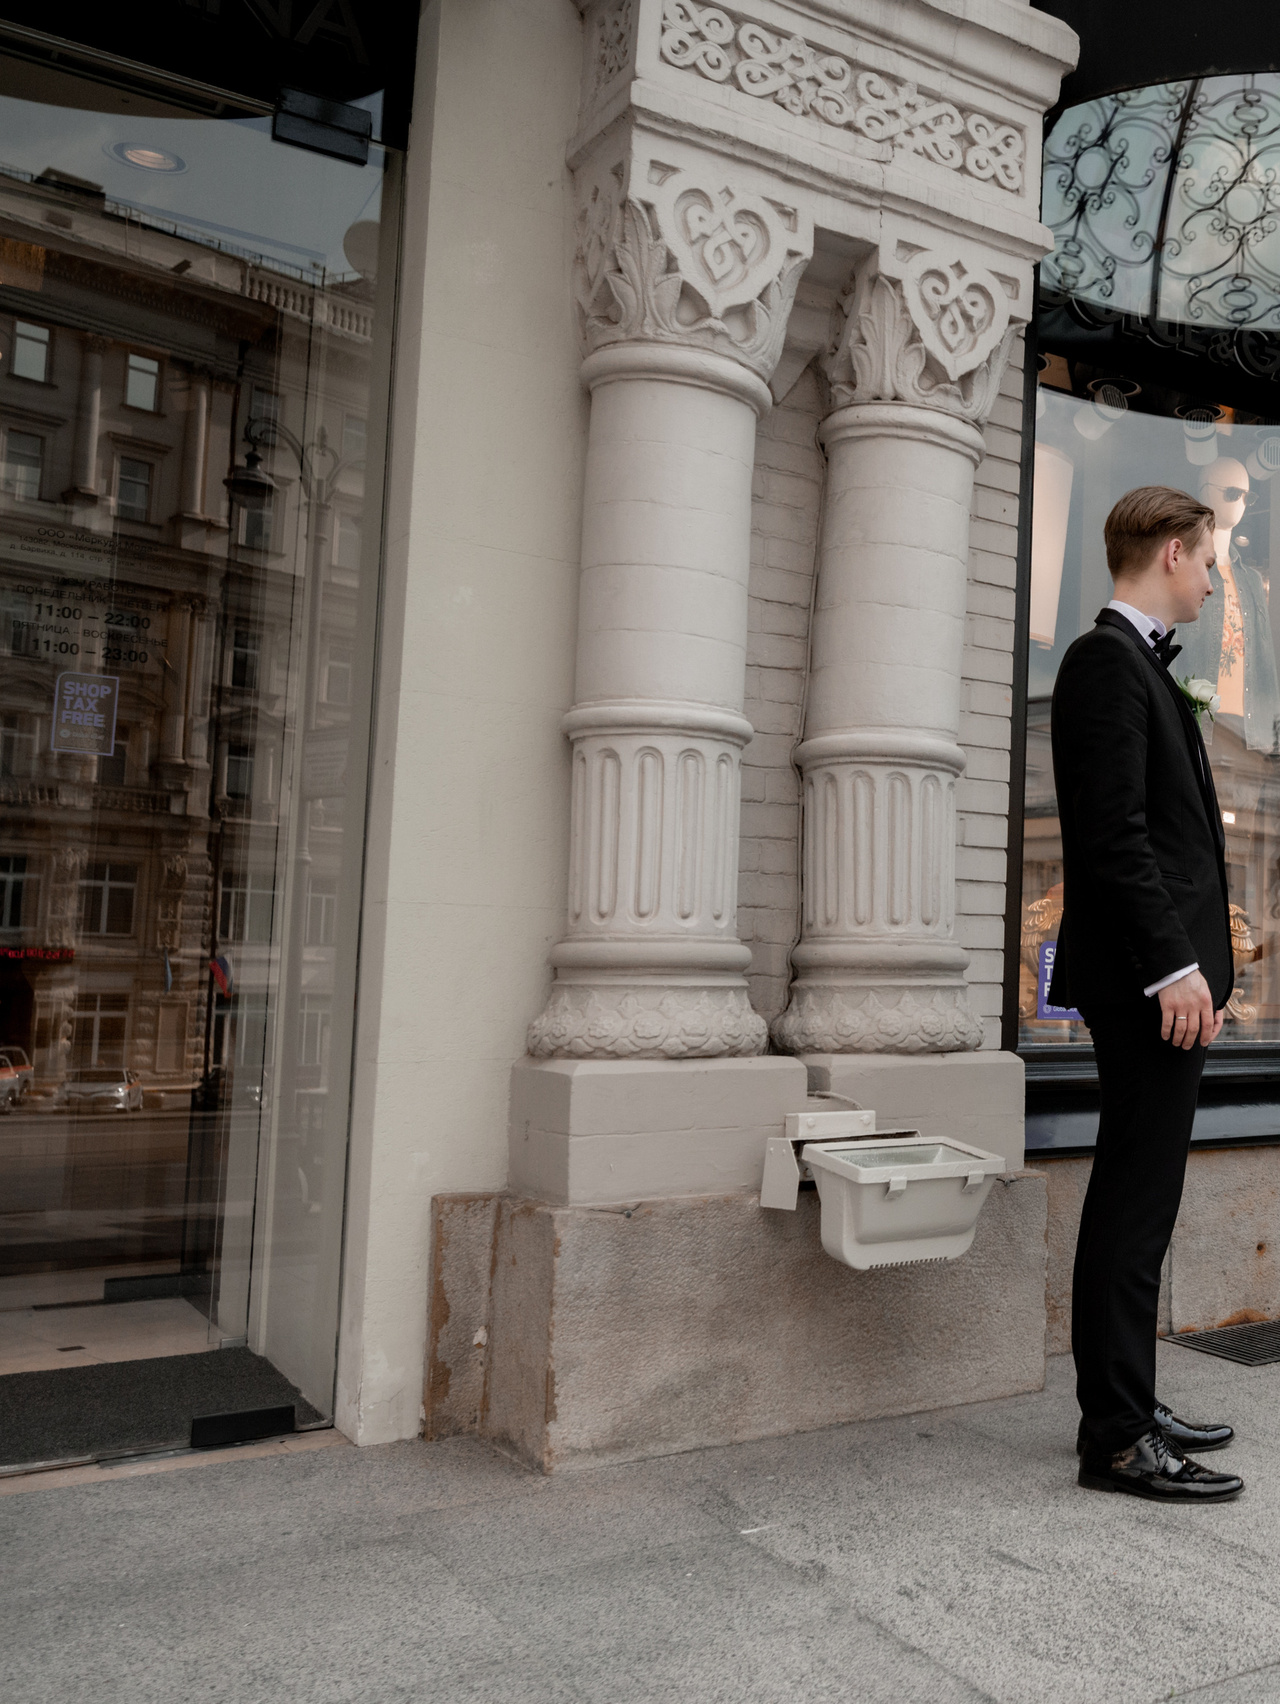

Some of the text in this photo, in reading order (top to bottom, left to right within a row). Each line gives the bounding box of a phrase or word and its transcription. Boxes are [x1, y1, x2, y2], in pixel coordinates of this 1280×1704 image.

[38, 527, 65, 539] ООО
[17, 584, 106, 604] ПОНЕДЕЛЬНИК
[89, 580, 136, 594] РАБОТЫ
[35, 603, 83, 620] 11:00
[104, 612, 151, 630] 22:00
[12, 620, 70, 635] ПЯТНИЦА
[83, 629, 168, 648] ВОСКРЕСЕНЬЕ
[32, 638, 80, 655] 11:00
[101, 647, 148, 664] 23:00
[63, 681, 112, 698] SHOP
[62, 695, 99, 712] TAX
[61, 710, 105, 728] FREE
